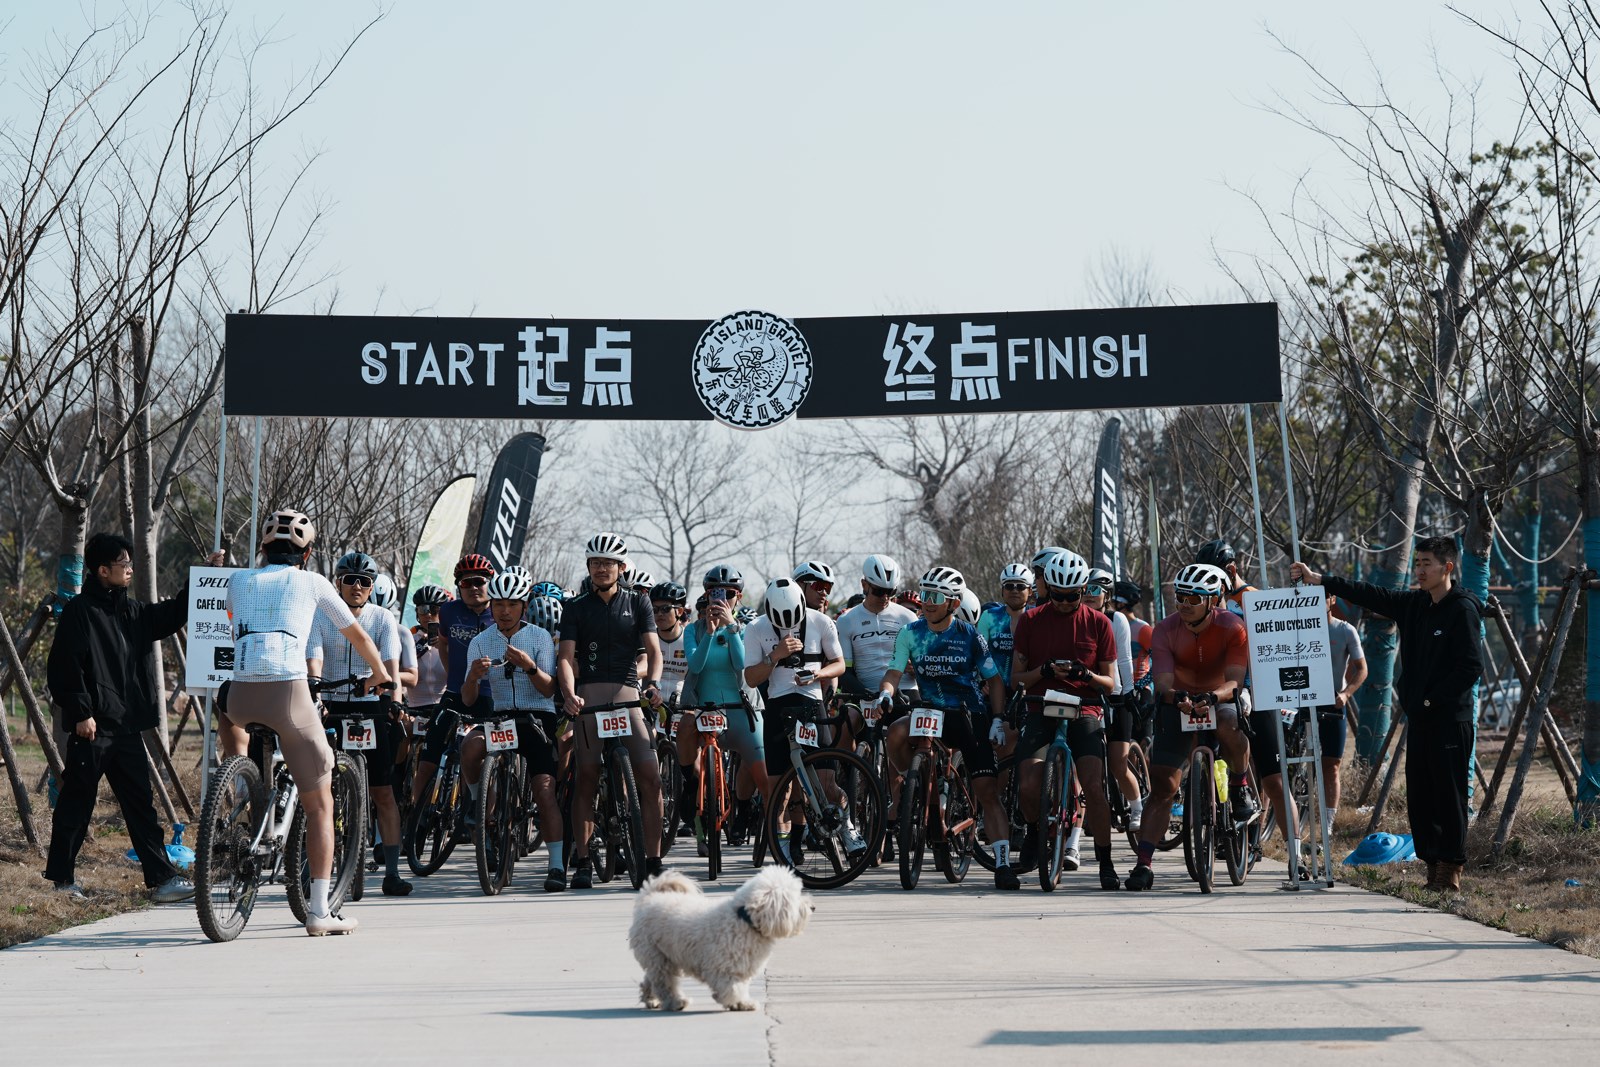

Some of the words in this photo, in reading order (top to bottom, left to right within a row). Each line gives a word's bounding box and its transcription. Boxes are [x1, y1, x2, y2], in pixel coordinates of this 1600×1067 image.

[714, 319, 763, 344] ISLAND
[768, 323, 805, 369] GRAVEL
[361, 342, 505, 386] START
[517, 326, 633, 406] 起点
[883, 321, 1001, 402] 终点
[1008, 334, 1148, 381] FINISH
[490, 478, 521, 576] IZED
[196, 577, 229, 588] SPECI
[196, 597, 215, 610] CAFÉ
[216, 599, 227, 610] DU
[1252, 596, 1320, 612] SPECIALIZED
[195, 621, 231, 636] 野趣
[1255, 619, 1274, 633] CAFÉ
[1274, 620, 1285, 632] DU
[1286, 617, 1321, 631] CYCLISTE
[1257, 640, 1323, 657] 野趣乡居
[924, 655, 967, 663] DECATHLON
[1257, 653, 1327, 663] wildhomestay.com
[602, 716, 627, 732] 095
[700, 715, 723, 727] 059
[915, 716, 938, 731] 001
[490, 729, 515, 743] 096
[799, 725, 816, 741] 094
